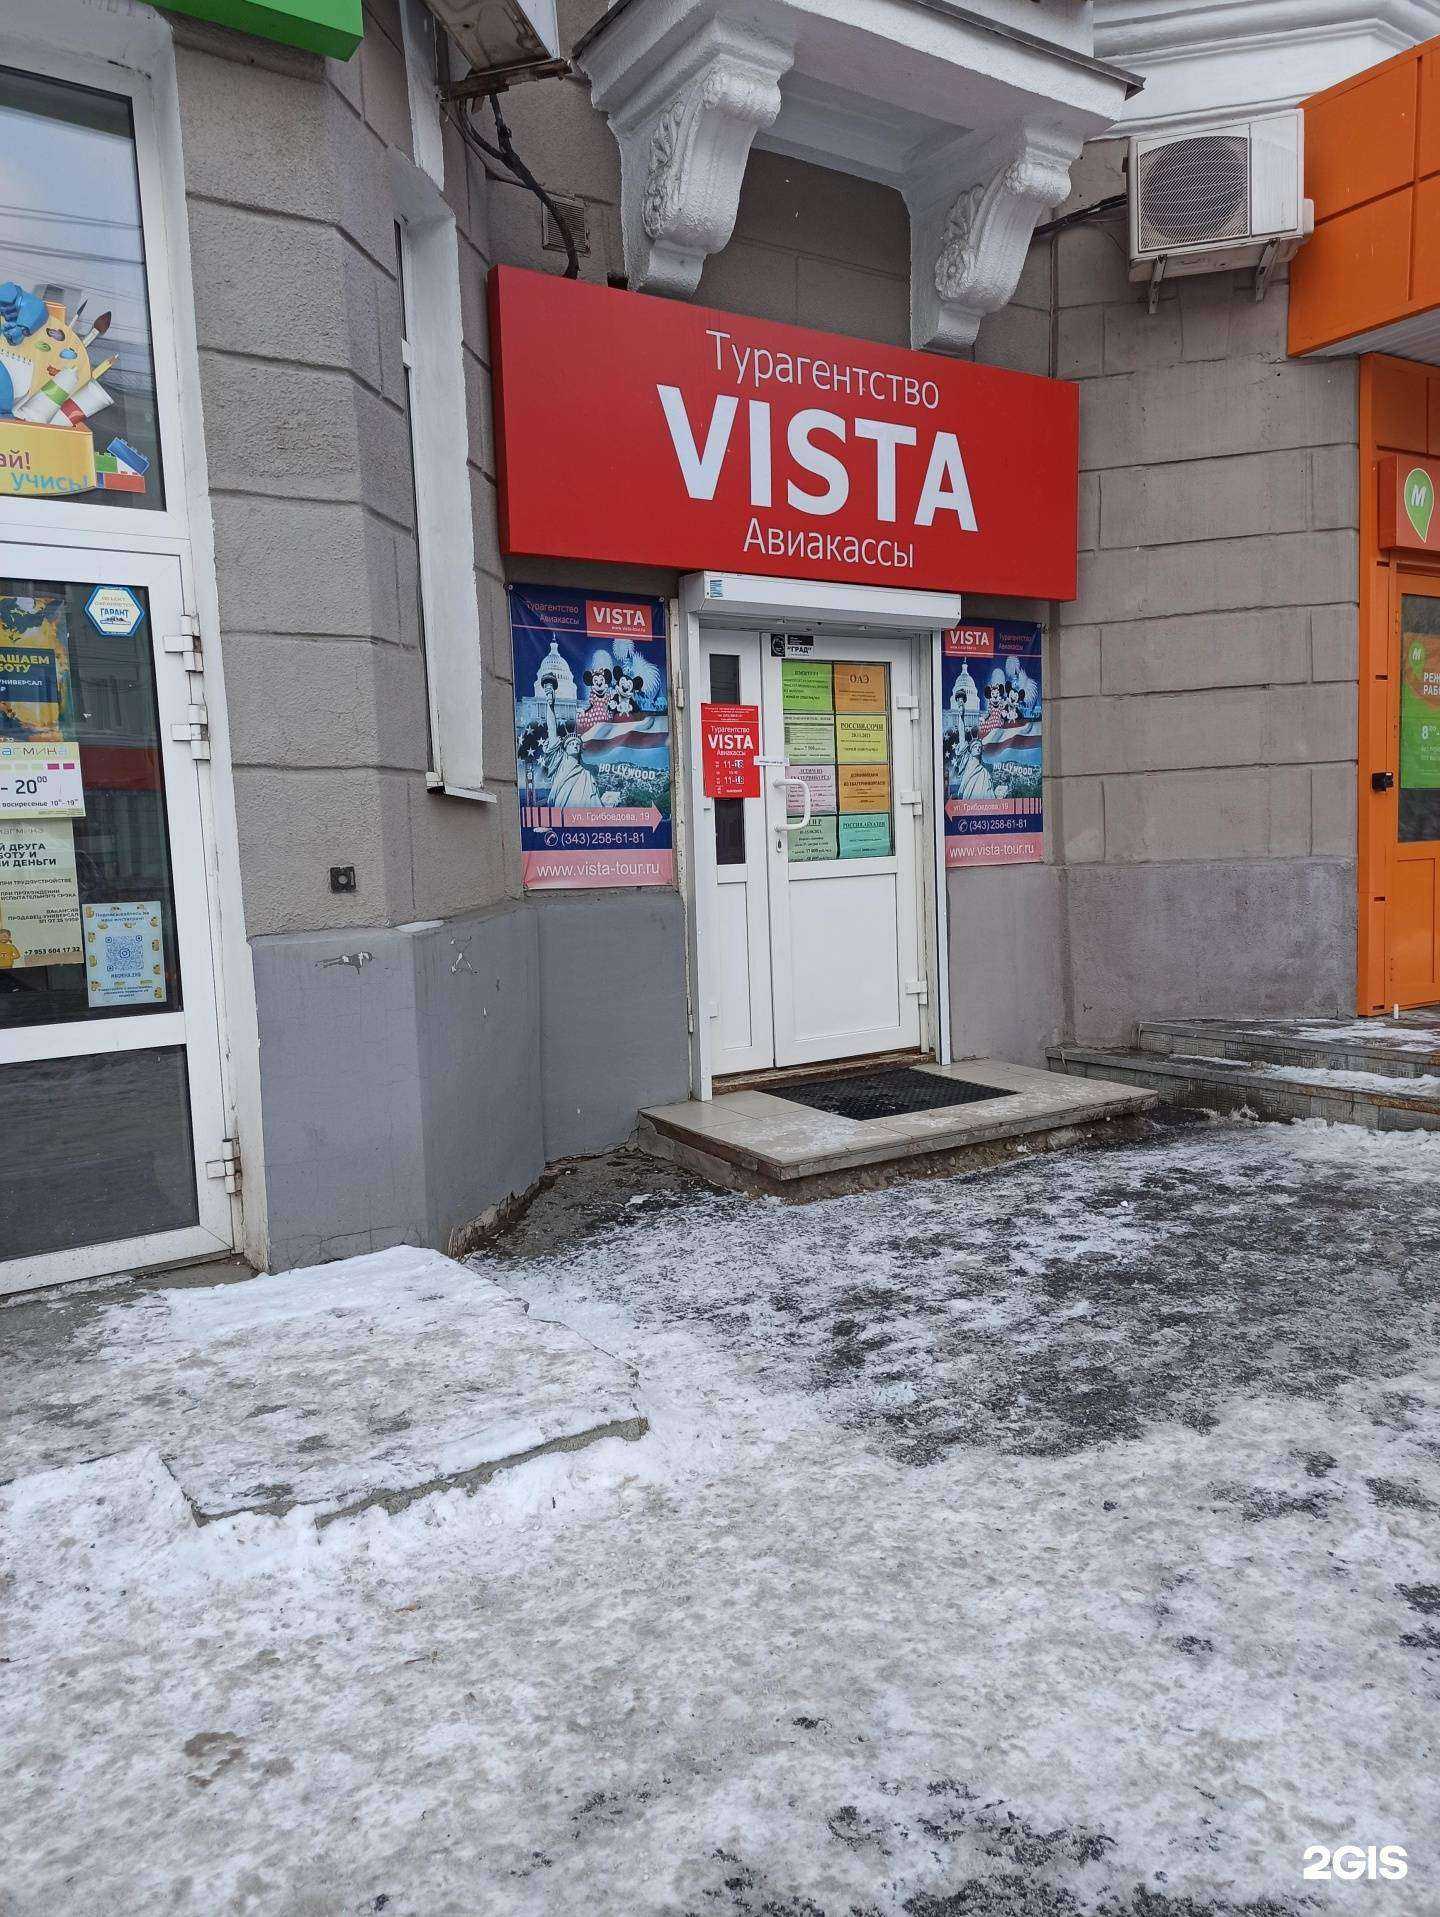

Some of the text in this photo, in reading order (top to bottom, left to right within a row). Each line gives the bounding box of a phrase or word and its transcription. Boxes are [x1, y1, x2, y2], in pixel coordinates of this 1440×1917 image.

[705, 329, 939, 409] Турагентство
[656, 383, 979, 532] VISTA
[743, 517, 914, 569] Авиакассы
[100, 608, 129, 618] ГАРАНТ
[592, 606, 646, 627] VISTA
[950, 630, 990, 646] VISTA
[849, 674, 870, 684] ОАЭ
[708, 734, 754, 750] VISTA
[598, 763, 656, 780] HOLLYWOOD
[640, 812, 650, 821] 19
[969, 819, 1027, 832] (343) 258-61-81
[561, 832, 645, 846] (343) 258-61-81
[9, 843, 46, 852] ДРУГА
[950, 843, 1034, 858] www.vista-tour.ru
[13, 858, 57, 868] ДЕНЬГИ
[536, 860, 660, 878] www.vista-tour.ru
